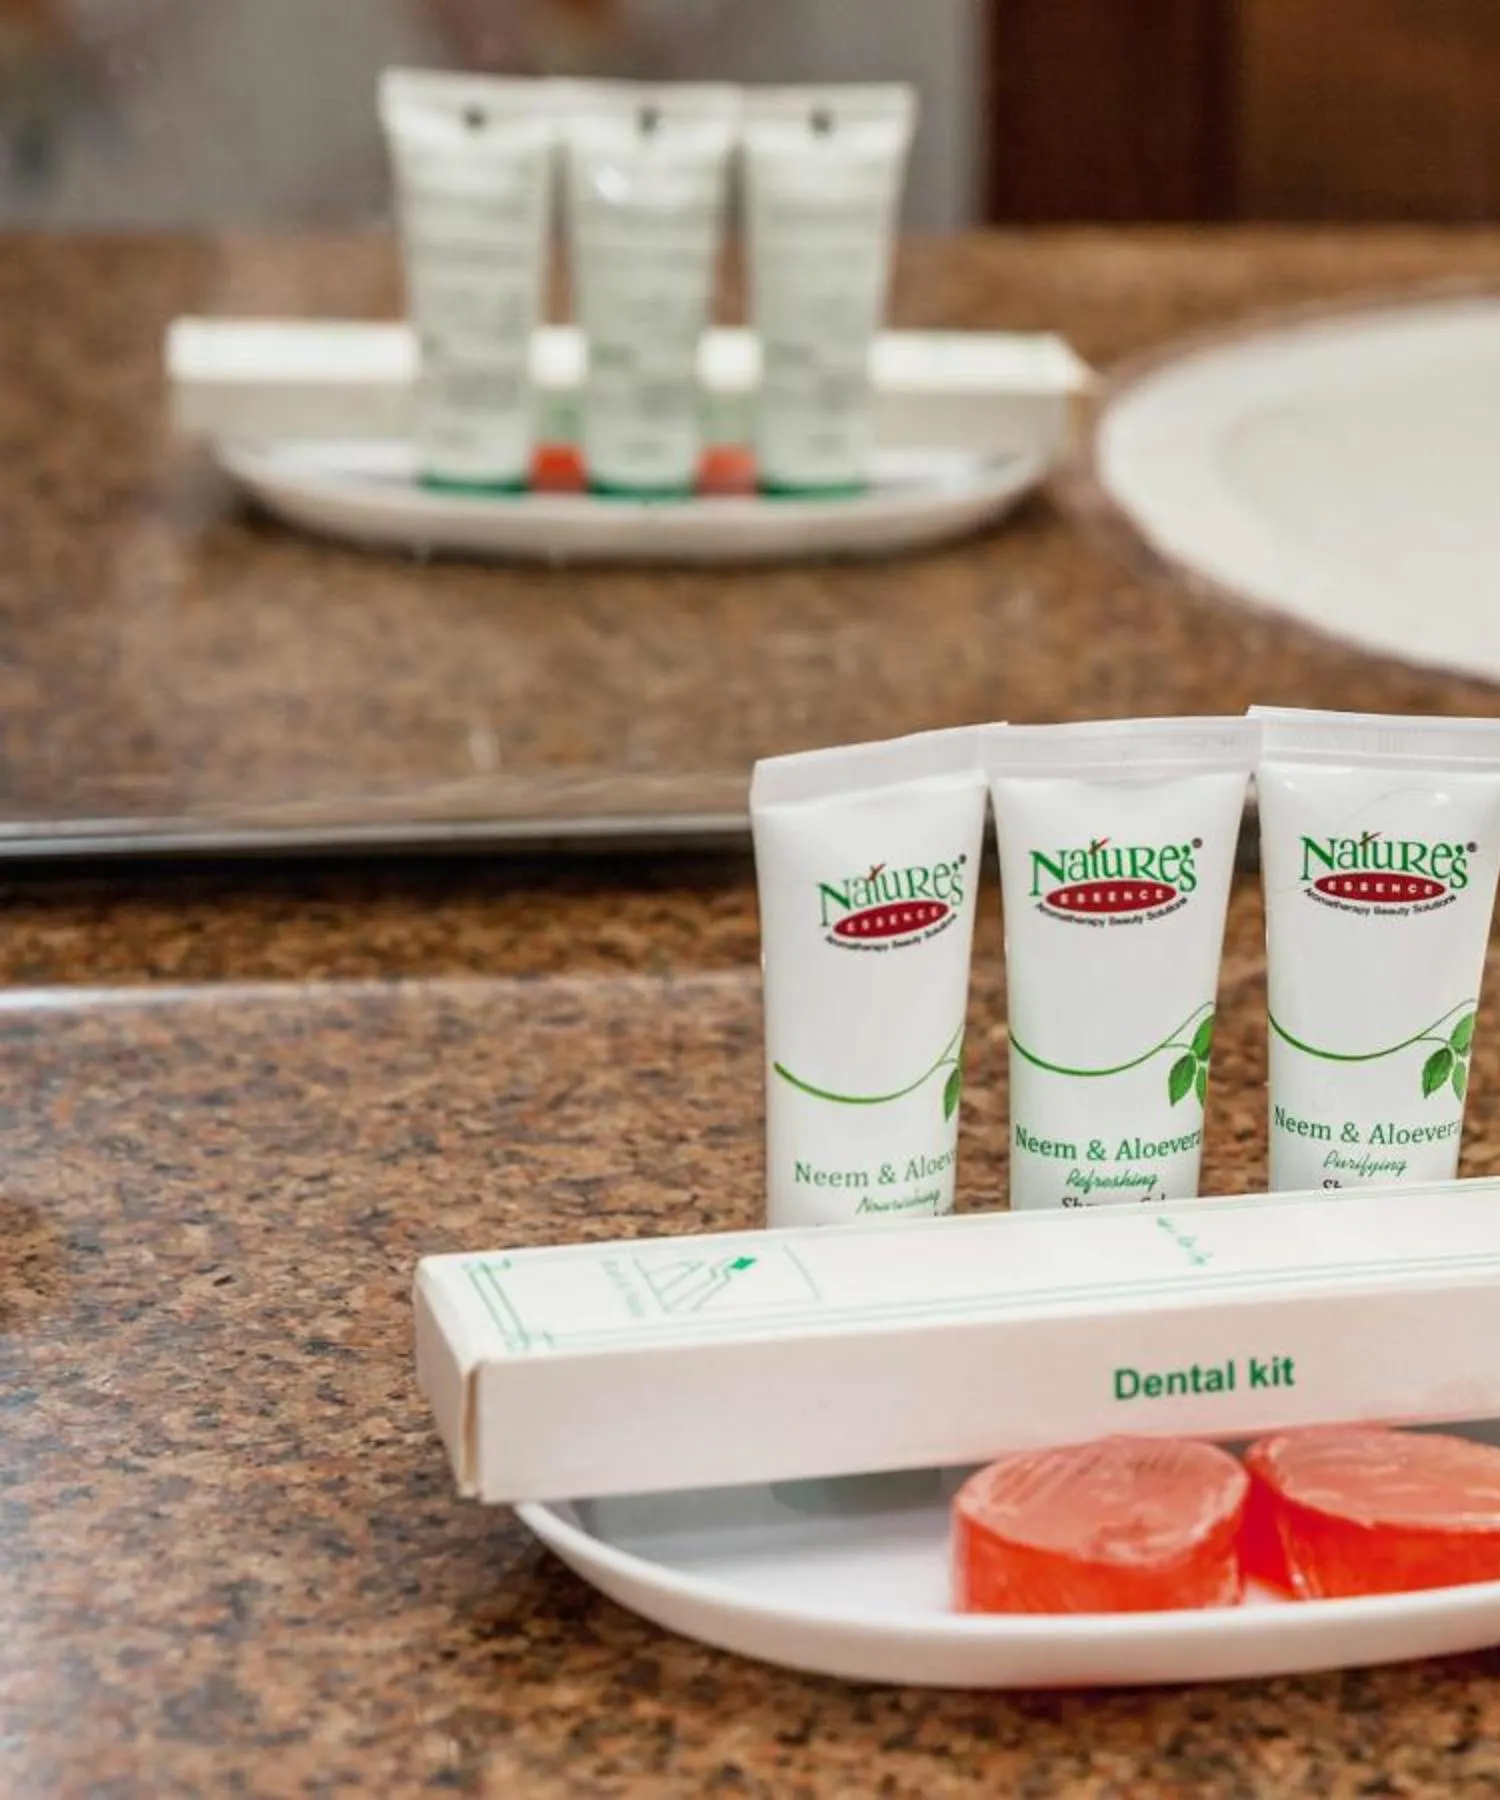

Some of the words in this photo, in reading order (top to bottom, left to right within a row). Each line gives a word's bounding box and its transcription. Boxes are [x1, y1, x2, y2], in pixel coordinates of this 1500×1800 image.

[1274, 1105, 1332, 1142] Neem
[1340, 1121, 1361, 1144] &
[1015, 1124, 1077, 1161] Neem
[1086, 1139, 1107, 1161] &
[794, 1161, 869, 1187] Neem
[877, 1164, 897, 1185] &
[1323, 1149, 1408, 1177] Purifying
[1065, 1167, 1159, 1194] Refreshing
[1114, 1359, 1236, 1400] Dental
[1248, 1355, 1296, 1389] kit
